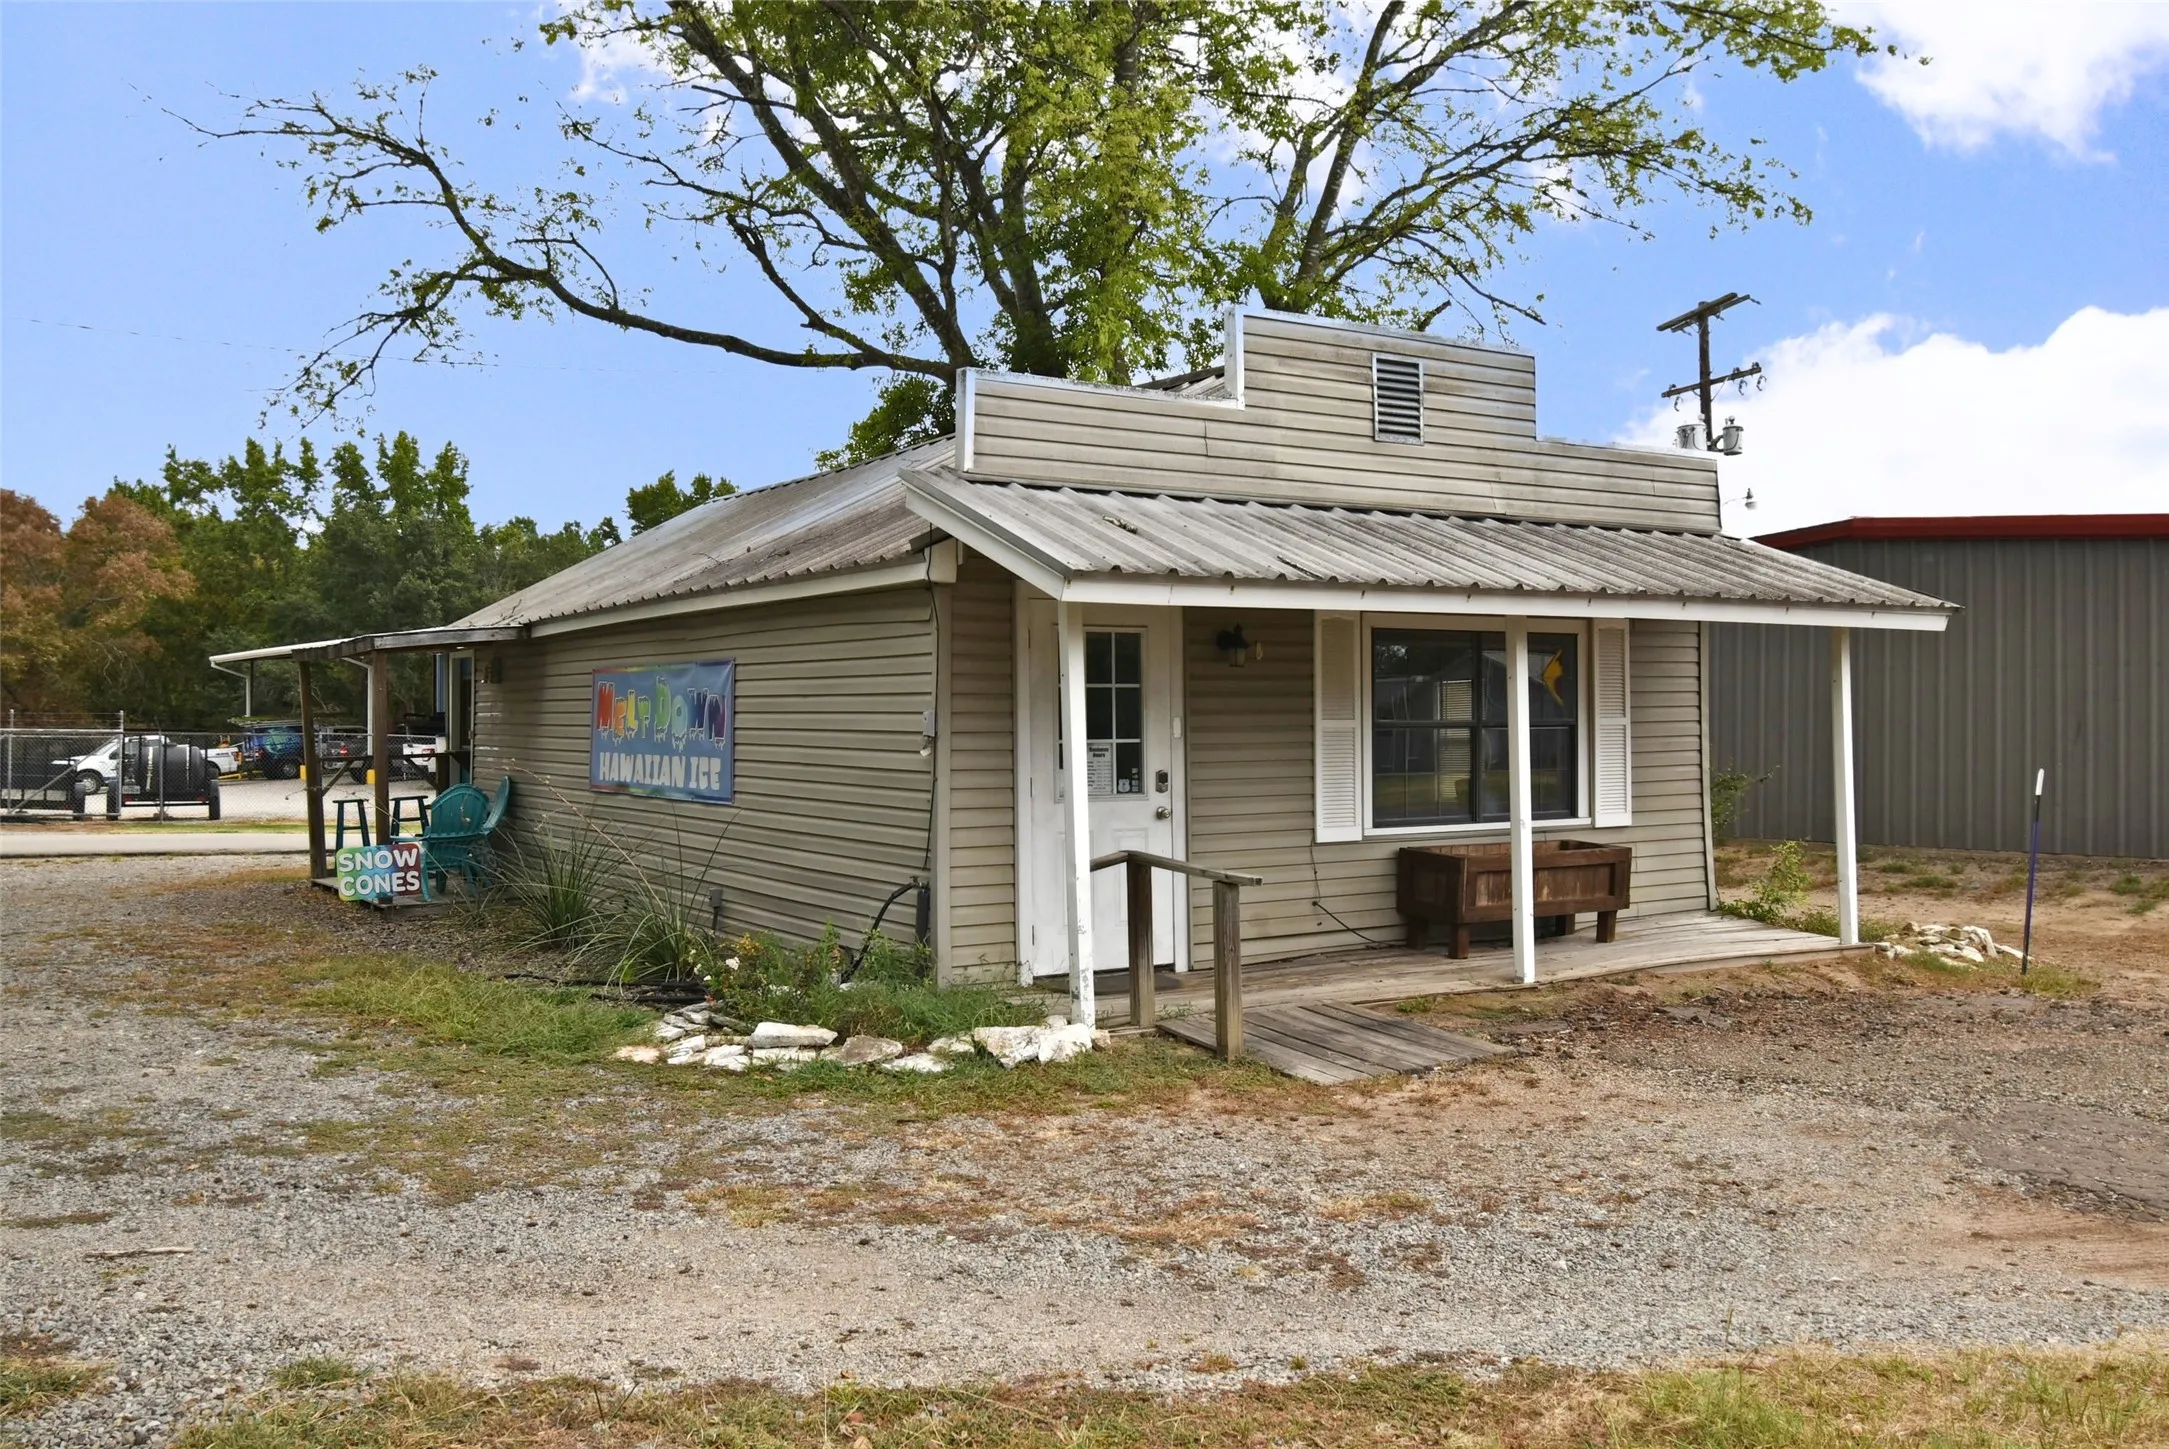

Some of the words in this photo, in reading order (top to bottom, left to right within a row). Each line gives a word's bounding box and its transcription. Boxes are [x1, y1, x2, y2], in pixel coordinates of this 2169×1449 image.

[599, 752, 686, 788] HAWAIIAN
[688, 757, 721, 790] ICE
[338, 848, 418, 872] SNOW
[340, 870, 420, 896] CONES
